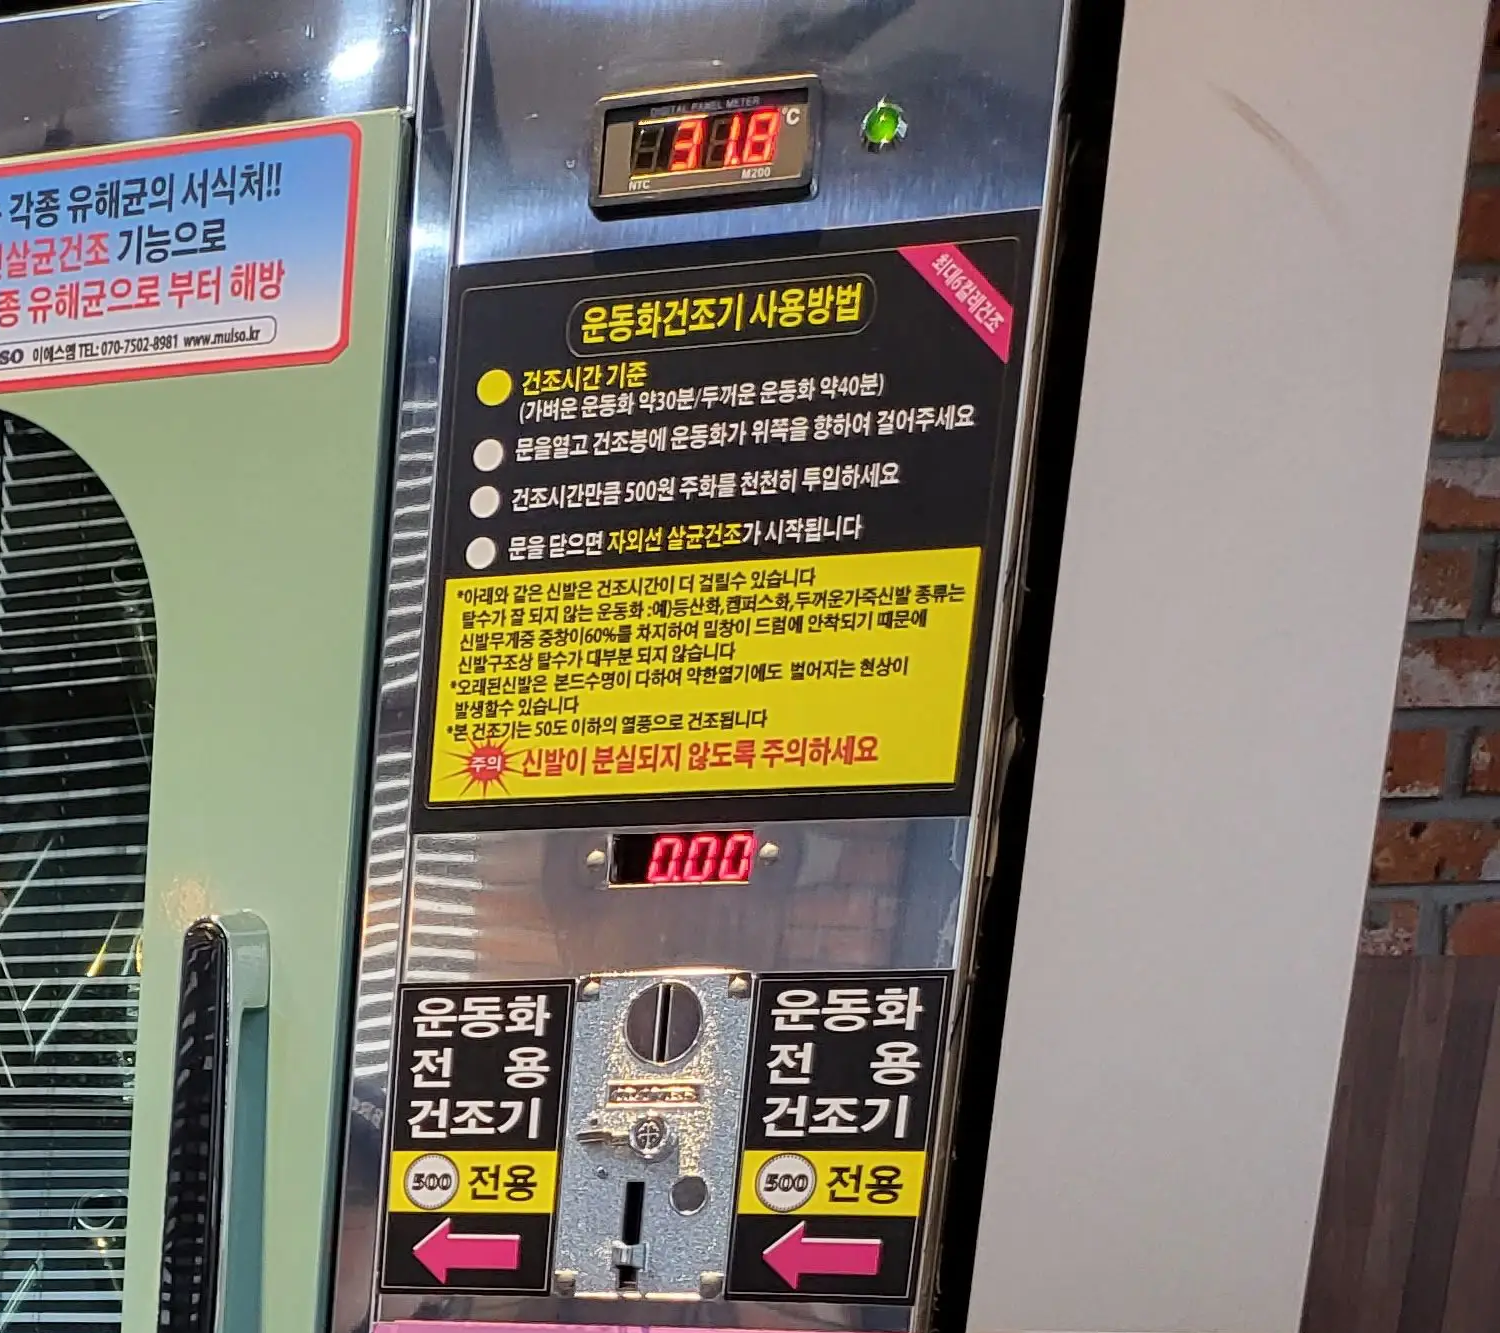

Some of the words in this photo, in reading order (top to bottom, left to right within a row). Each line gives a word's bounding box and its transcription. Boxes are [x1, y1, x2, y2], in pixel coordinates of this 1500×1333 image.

[9, 187, 61, 230] 각종
[67, 173, 175, 224] 유해균의
[182, 161, 282, 206] 서식처!!
[629, 180, 650, 190] NTC
[741, 168, 771, 179] M200
[118, 217, 227, 266] 기능으로
[28, 269, 161, 324] 유해균으로
[167, 264, 220, 308] 부터
[231, 259, 285, 301] 해방
[581, 292, 744, 344] 운동화건조기
[749, 282, 864, 329] 사용방법
[101, 334, 179, 356] 070-7502-8981
[183, 325, 261, 348] www.mulso.kr
[518, 397, 578, 424] (가벼운
[581, 392, 634, 418] 운동화
[760, 378, 816, 404] 운동화
[820, 372, 884, 400] 약40분)
[521, 364, 601, 396] 건조시간
[606, 361, 649, 390] 기준
[515, 434, 588, 462] 문을열고
[592, 426, 667, 456] 건조봉에
[669, 420, 746, 451] 운동화가
[751, 417, 815, 444] 위쪽을
[813, 412, 871, 440] 향하여
[876, 404, 975, 435] 걸어주세요
[511, 481, 621, 512] 건조시간만큼
[624, 477, 675, 504] 500원
[679, 472, 736, 500] 주화를
[740, 468, 798, 495] 천천히
[801, 462, 900, 491] 투입하세요
[508, 536, 545, 561] 문을
[607, 525, 662, 554] 자외선
[667, 519, 762, 553] 살균건조가
[764, 514, 863, 545] 시작됩니다
[514, 584, 543, 604] 같은
[547, 581, 593, 601] 신발은
[597, 576, 674, 599] 건조시간이
[679, 575, 694, 593] 더
[699, 572, 747, 592] 걸릴수
[751, 567, 815, 589] 있습니다
[471, 757, 502, 773] 주의
[522, 747, 587, 778] 신발이
[592, 743, 681, 774] 분실되지
[688, 739, 755, 771] 않도록
[761, 735, 878, 768] 주의하세요
[411, 995, 551, 1038] 운동화
[771, 987, 923, 1032] 운동화
[407, 1096, 541, 1141] 건조기
[761, 1094, 909, 1139] 건조기
[411, 1173, 452, 1191] 500
[468, 1164, 538, 1202] 전용
[763, 1173, 809, 1193] 500
[826, 1166, 904, 1204] 전용
